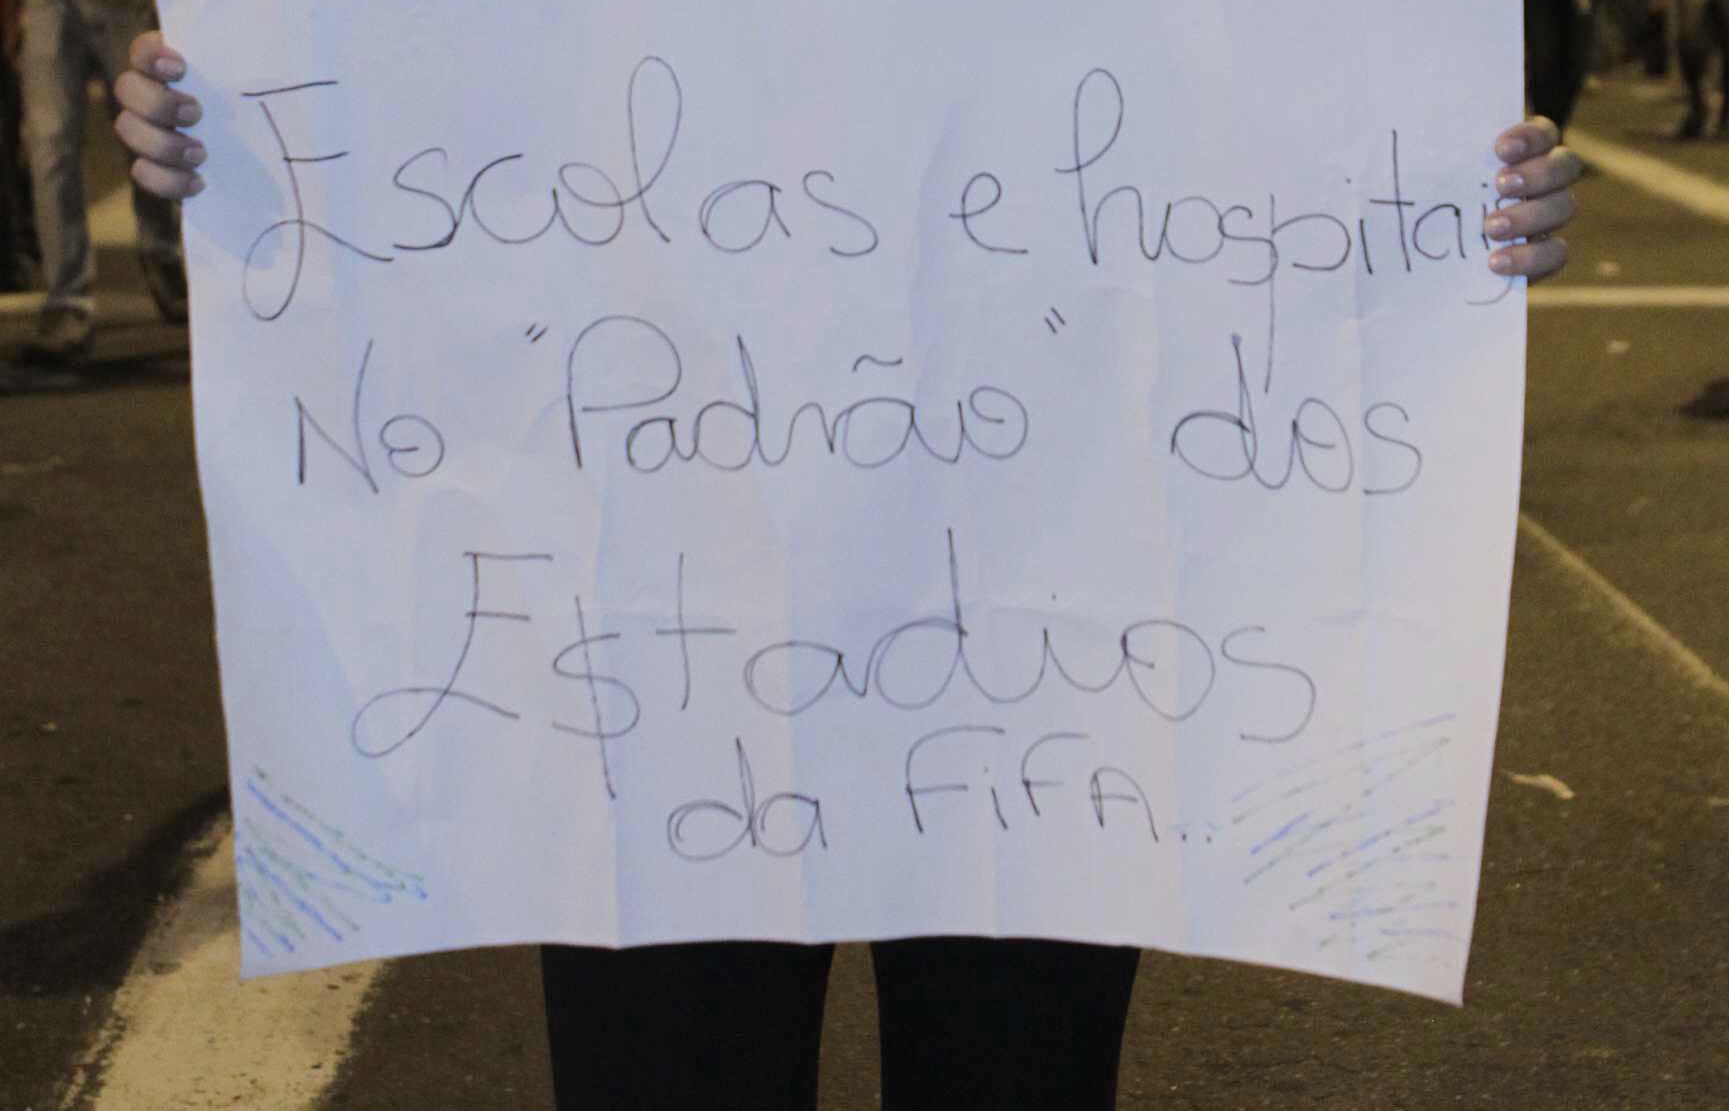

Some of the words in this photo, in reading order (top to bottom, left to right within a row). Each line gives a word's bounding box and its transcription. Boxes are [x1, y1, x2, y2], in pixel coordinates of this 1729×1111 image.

[241, 55, 879, 321] Escolas
[947, 172, 1028, 255] e
[294, 338, 445, 494] No
[1170, 333, 1422, 496] dos
[666, 737, 827, 861] da
